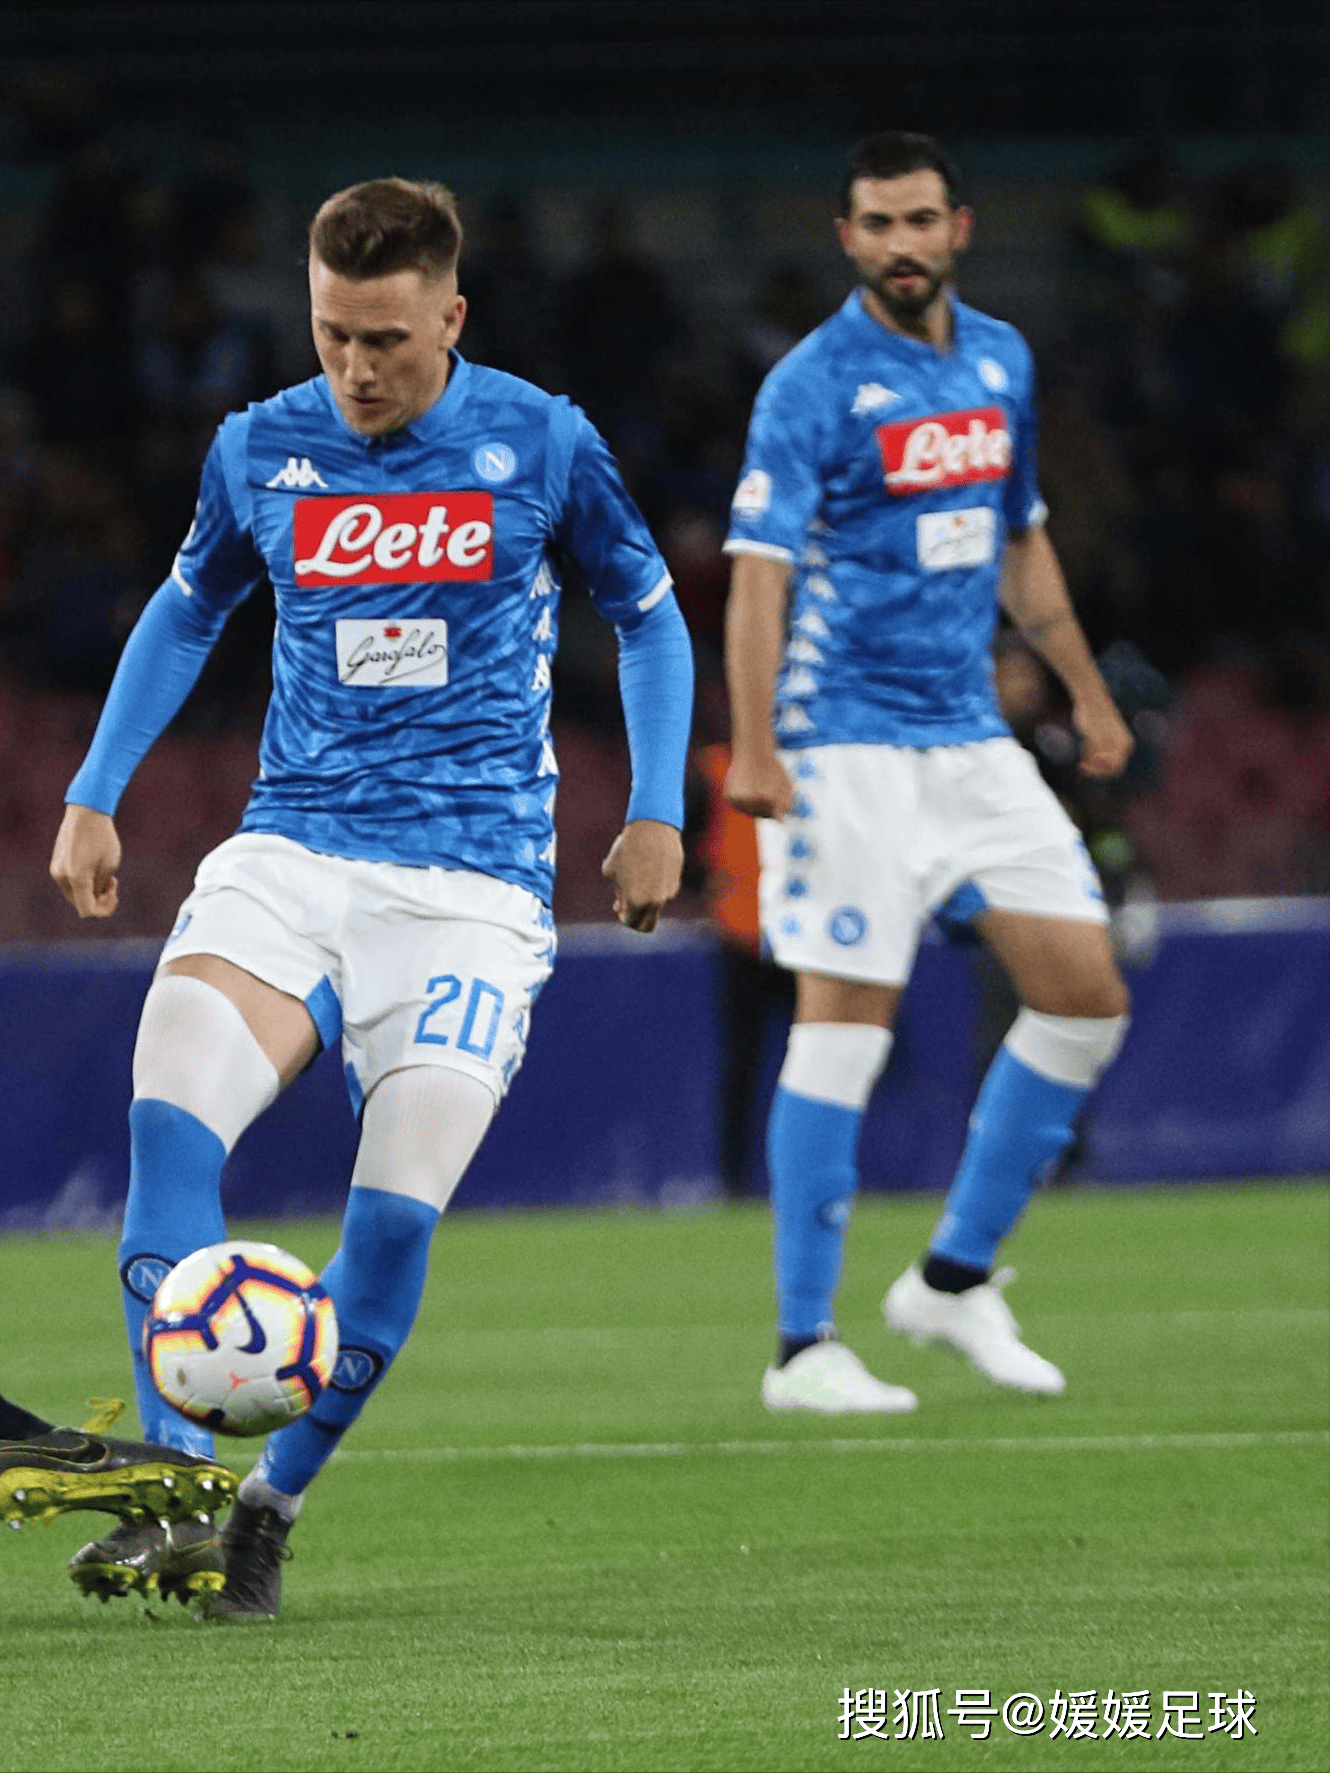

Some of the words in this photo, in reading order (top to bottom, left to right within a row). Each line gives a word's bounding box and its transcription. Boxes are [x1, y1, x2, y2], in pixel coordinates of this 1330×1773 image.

[883, 418, 1012, 484] Lete
[294, 503, 492, 578] Lete
[340, 628, 446, 684] Garofalo
[413, 973, 506, 1061] 20
